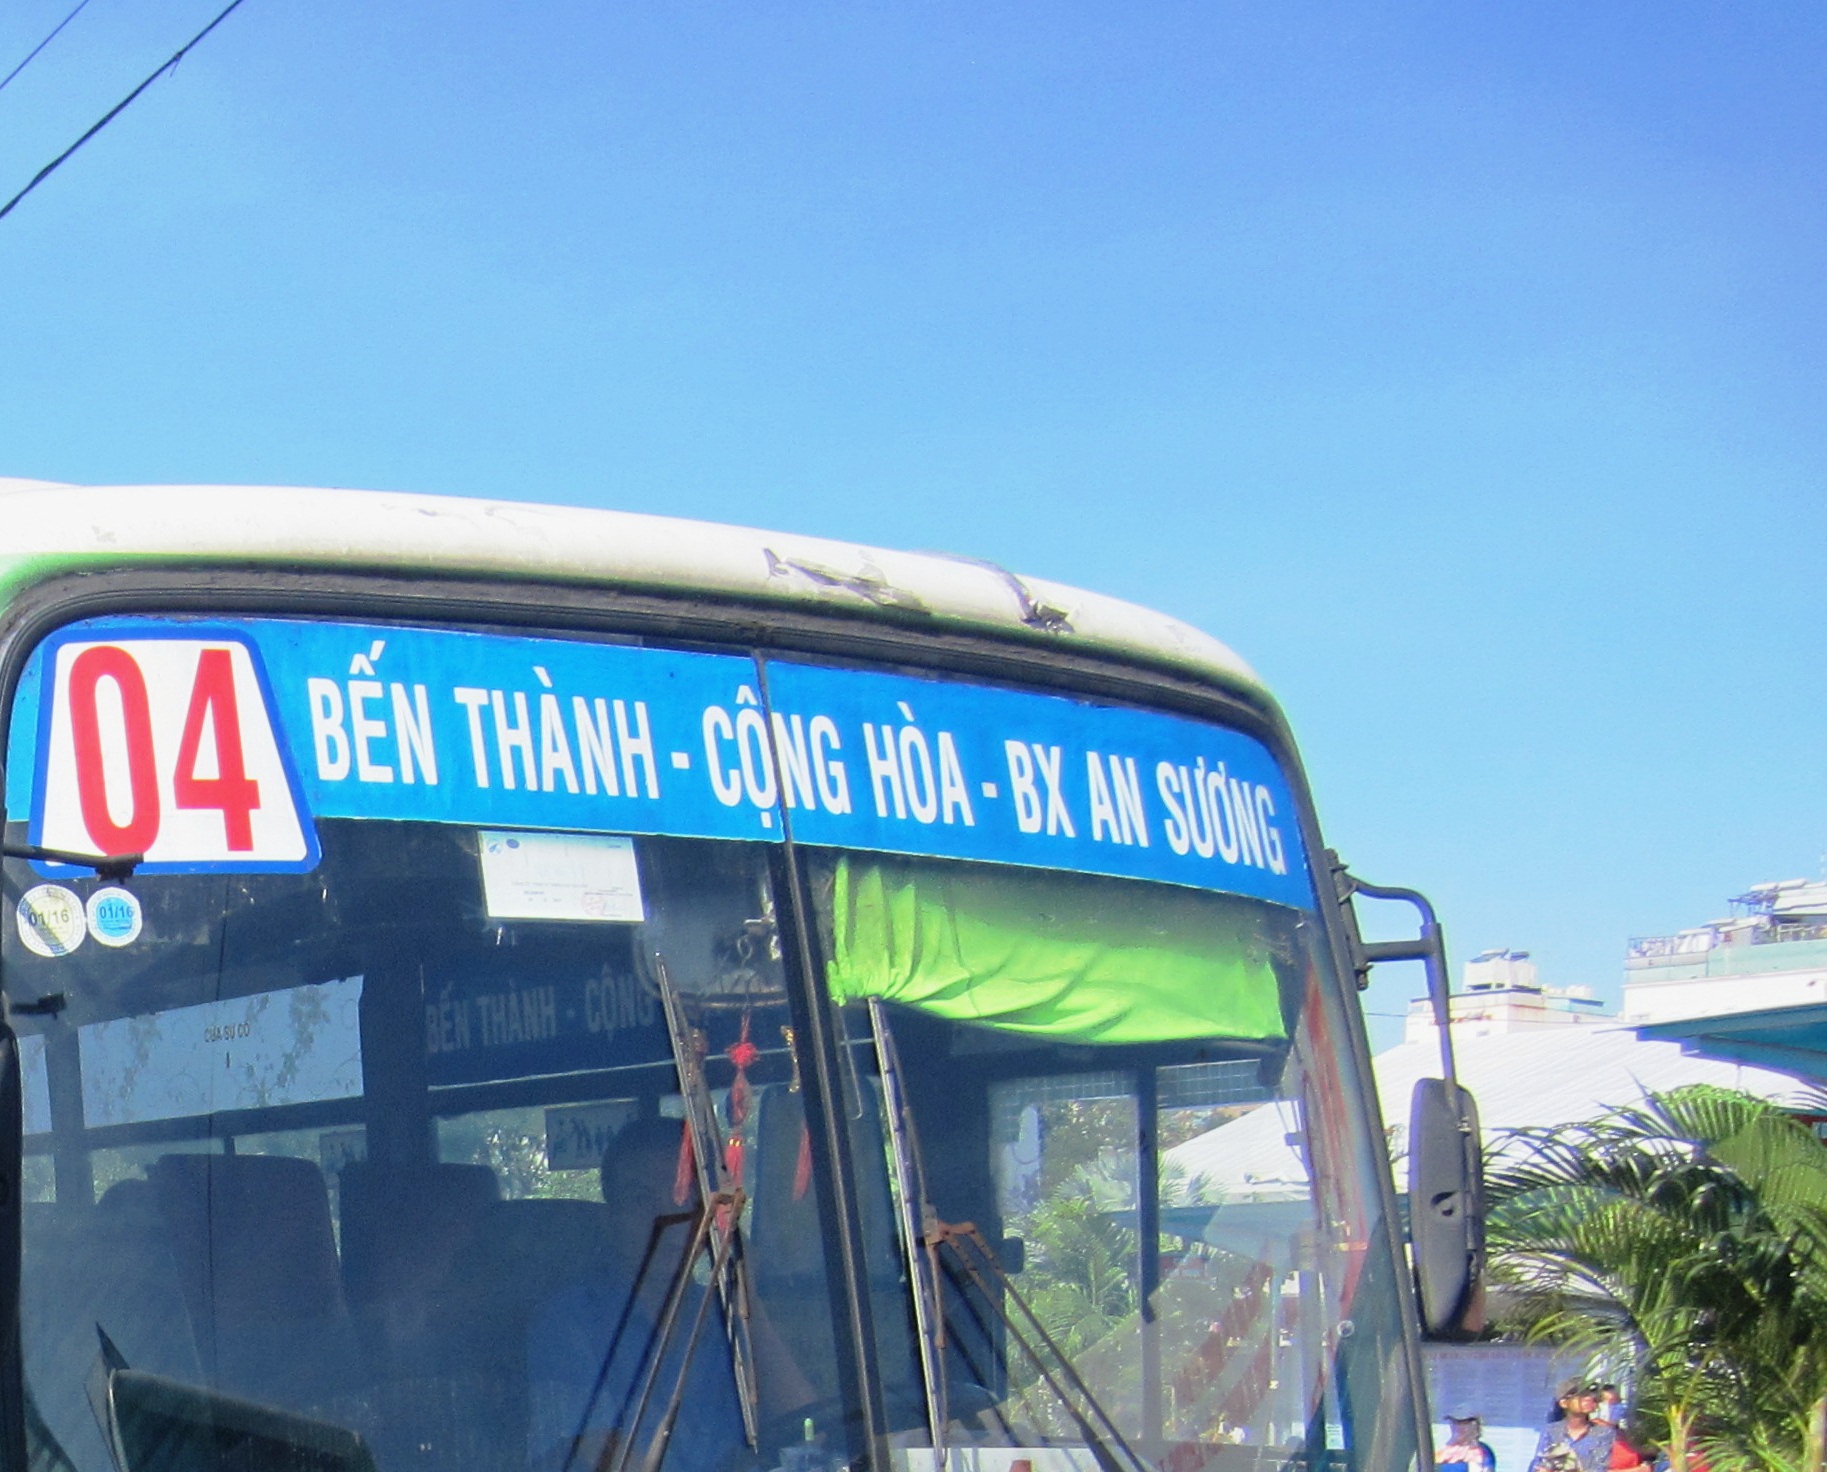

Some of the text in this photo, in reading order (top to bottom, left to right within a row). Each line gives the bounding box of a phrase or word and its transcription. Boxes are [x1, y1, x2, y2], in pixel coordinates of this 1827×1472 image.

[68, 645, 261, 856] 04
[307, 640, 438, 786] BẾN
[453, 666, 659, 799] THÀNH
[702, 685, 852, 828] CỘNG
[862, 701, 975, 826] HÒA
[1004, 740, 1076, 838] BX
[1086, 751, 1149, 848] AN
[1156, 756, 1287, 876] SƯƠNG
[29, 908, 69, 926] 01/16
[99, 905, 134, 920] 01/16
